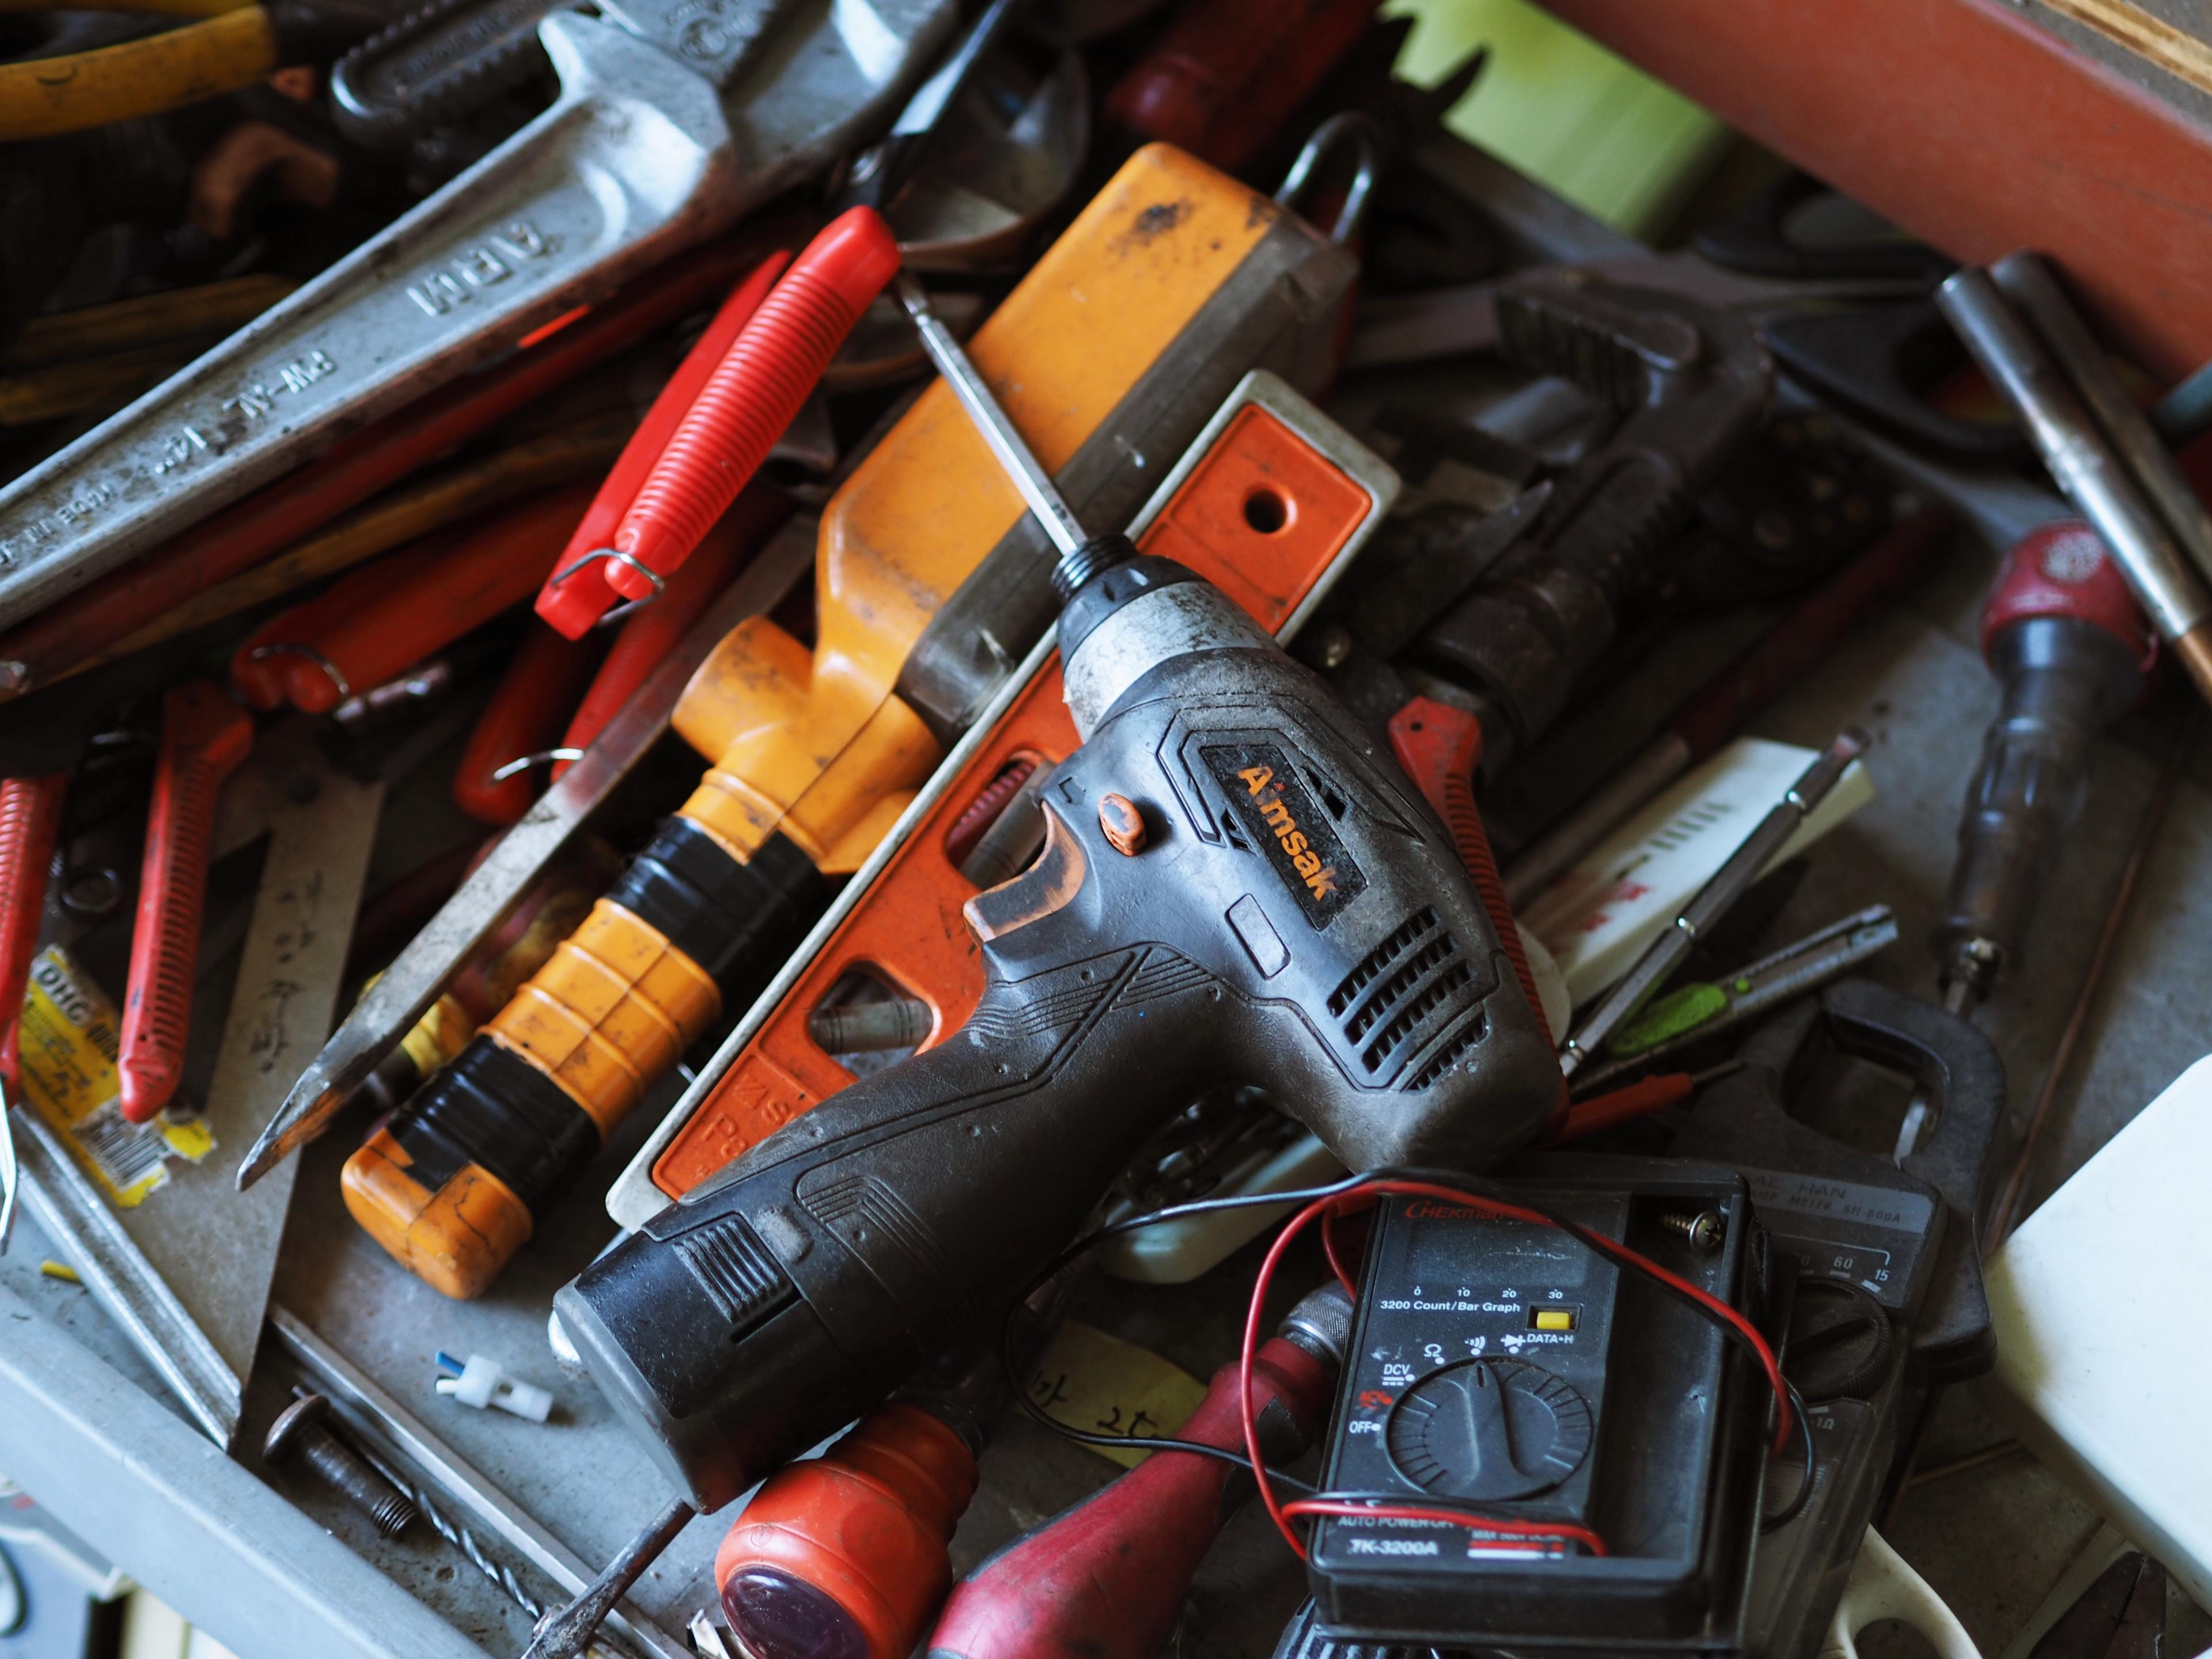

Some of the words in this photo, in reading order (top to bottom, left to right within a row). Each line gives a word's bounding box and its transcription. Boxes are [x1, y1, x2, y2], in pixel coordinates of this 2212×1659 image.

[1834, 1256, 1853, 1270] 60
[1874, 1268, 1889, 1282] 15
[1414, 1287, 1421, 1296] 0
[1457, 1289, 1471, 1297] 10
[1502, 1290, 1517, 1298] 20
[1548, 1291, 1563, 1300] 30
[1380, 1300, 1410, 1310] 3200
[1413, 1301, 1479, 1312] Count/Bar
[1482, 1302, 1521, 1313] Graph
[1383, 1363, 1411, 1376] DCV
[1349, 1420, 1373, 1434] OFF
[1337, 1516, 1376, 1527] AUTO
[1377, 1516, 1430, 1528] POWER
